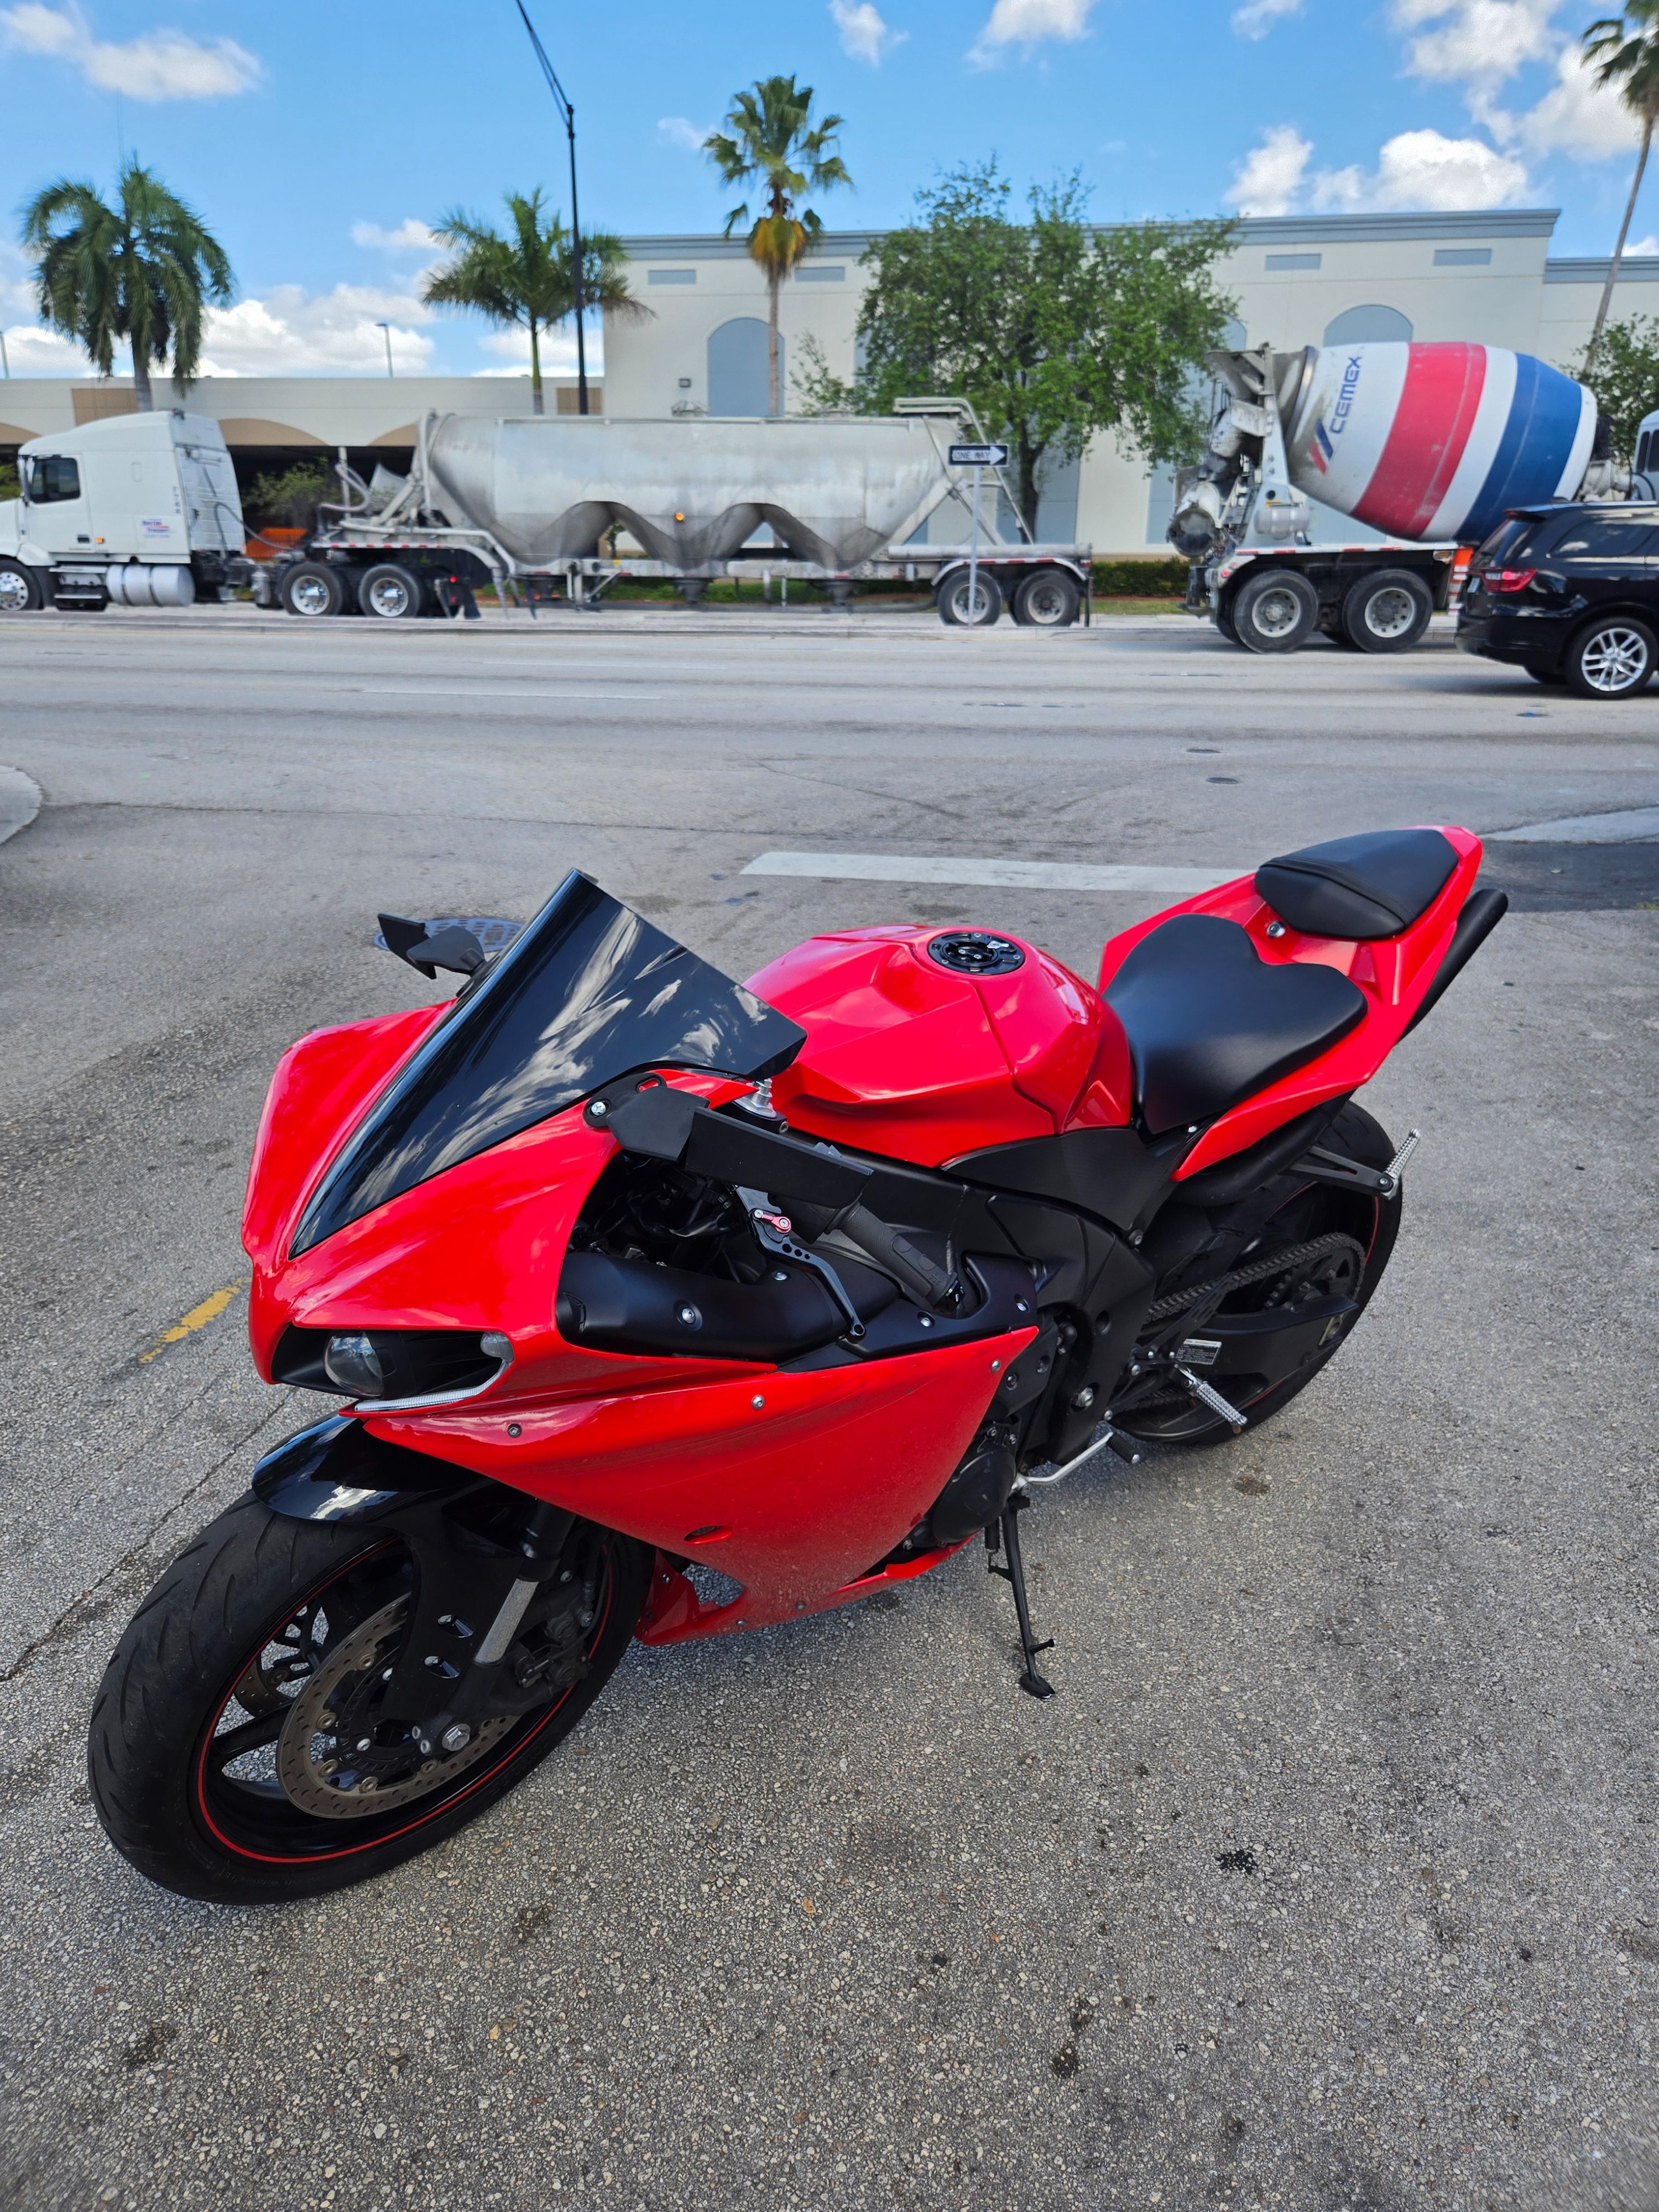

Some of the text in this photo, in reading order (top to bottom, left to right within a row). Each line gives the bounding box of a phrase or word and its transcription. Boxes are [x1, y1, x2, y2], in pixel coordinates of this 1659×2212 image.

[1329, 356, 1362, 435] CEMEX
[954, 451, 990, 460] ONE WAY
